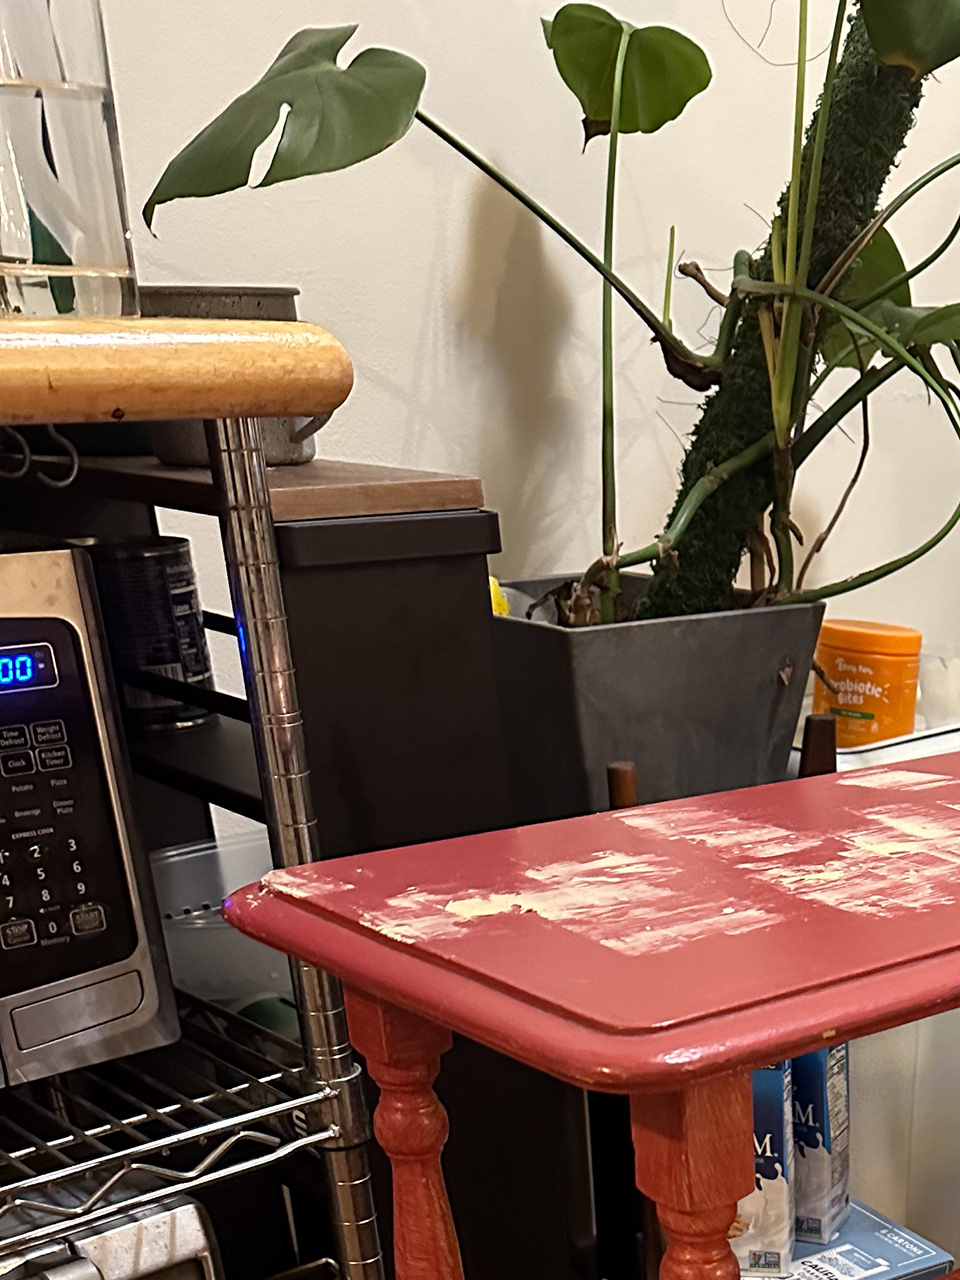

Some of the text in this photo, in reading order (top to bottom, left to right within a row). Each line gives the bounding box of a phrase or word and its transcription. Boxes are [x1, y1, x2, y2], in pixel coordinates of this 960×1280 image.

[834, 679, 882, 698] robiotic
[837, 692, 864, 704] Bites
[36, 725, 60, 735] Weight
[41, 750, 65, 759] Kitchen
[8, 758, 26, 768] Clock
[50, 778, 68, 787] Pizza
[11, 830, 37, 840] EXPRESS
[68, 839, 77, 851] 3
[29, 845, 41, 858] 2
[73, 861, 81, 873] 6
[2, 874, 10, 886] 4
[37, 868, 45, 880] 5
[77, 882, 86, 894] 9
[41, 889, 50, 901] 8
[6, 896, 14, 908] 7
[48, 921, 57, 933] 0
[887, 1232, 924, 1255] CARTONS
